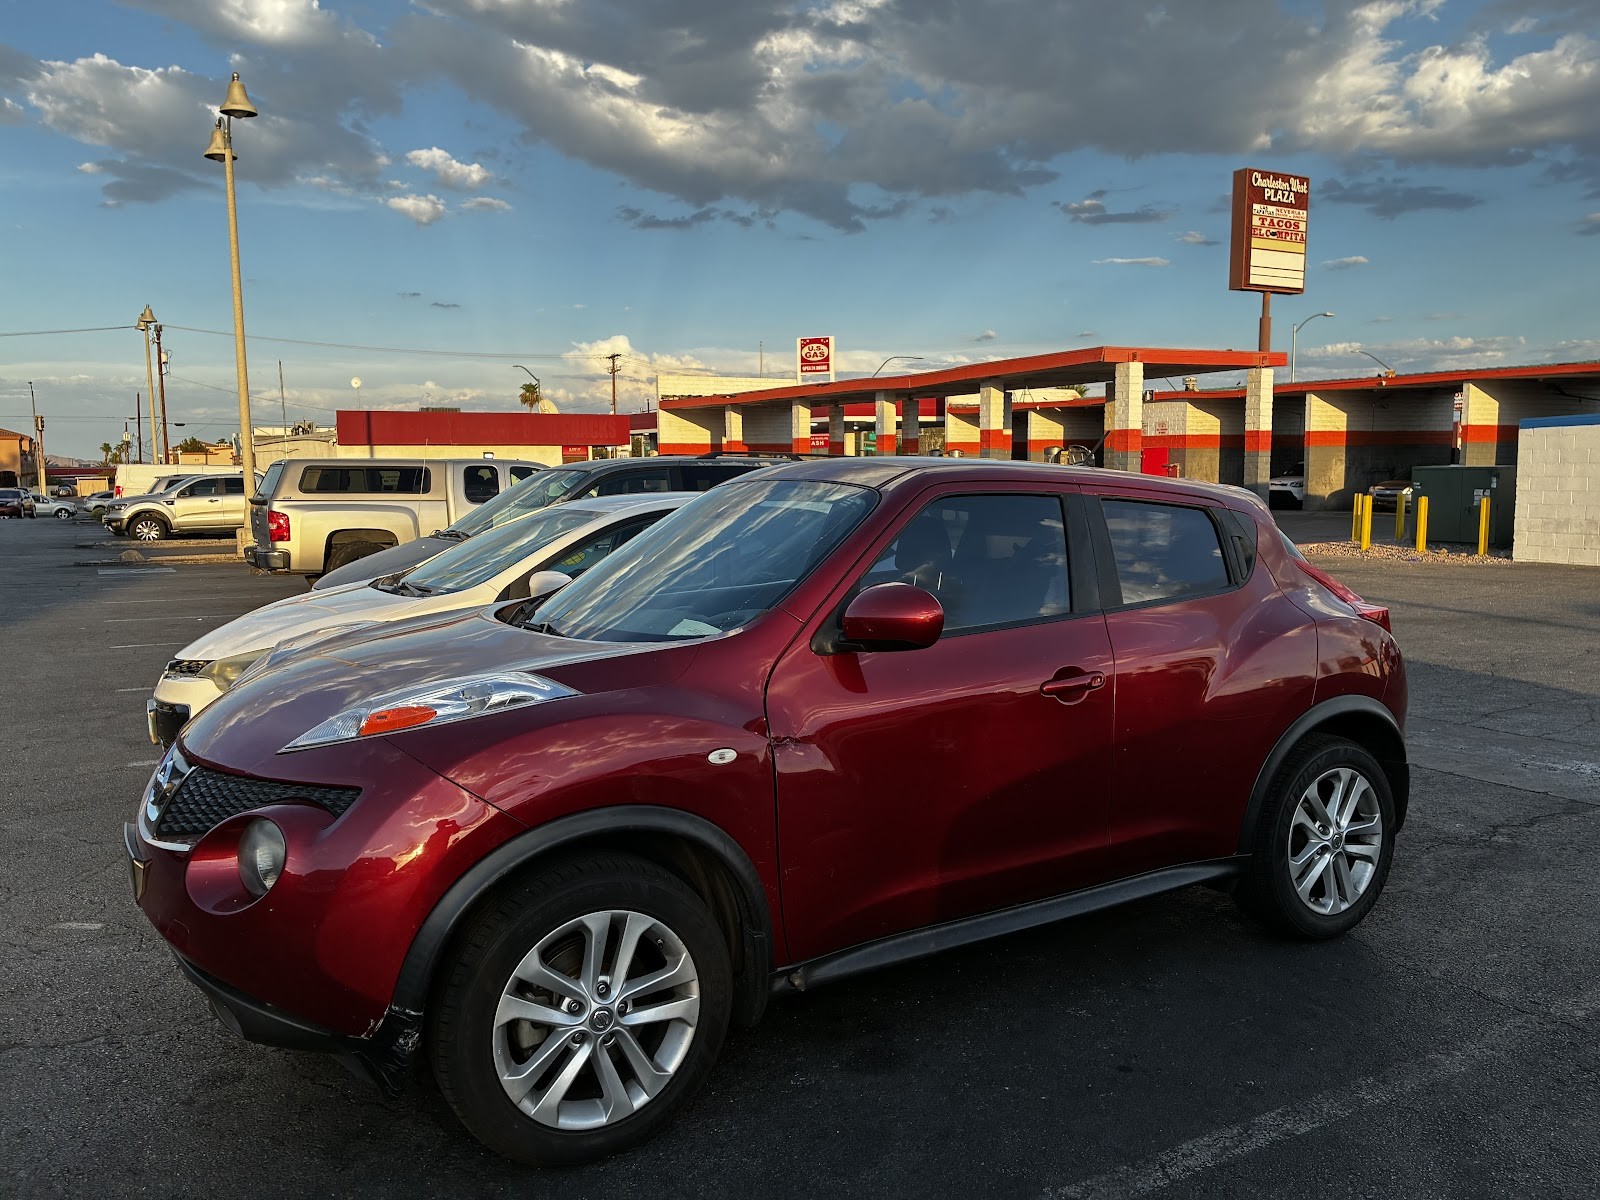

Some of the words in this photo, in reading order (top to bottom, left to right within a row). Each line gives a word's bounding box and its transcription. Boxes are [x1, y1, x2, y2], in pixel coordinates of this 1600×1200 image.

[1252, 172, 1290, 191] Charleston
[1290, 178, 1308, 194] West
[1264, 188, 1295, 204] PLAZA
[1259, 217, 1300, 230] TACOS
[1252, 228, 1264, 236] EL
